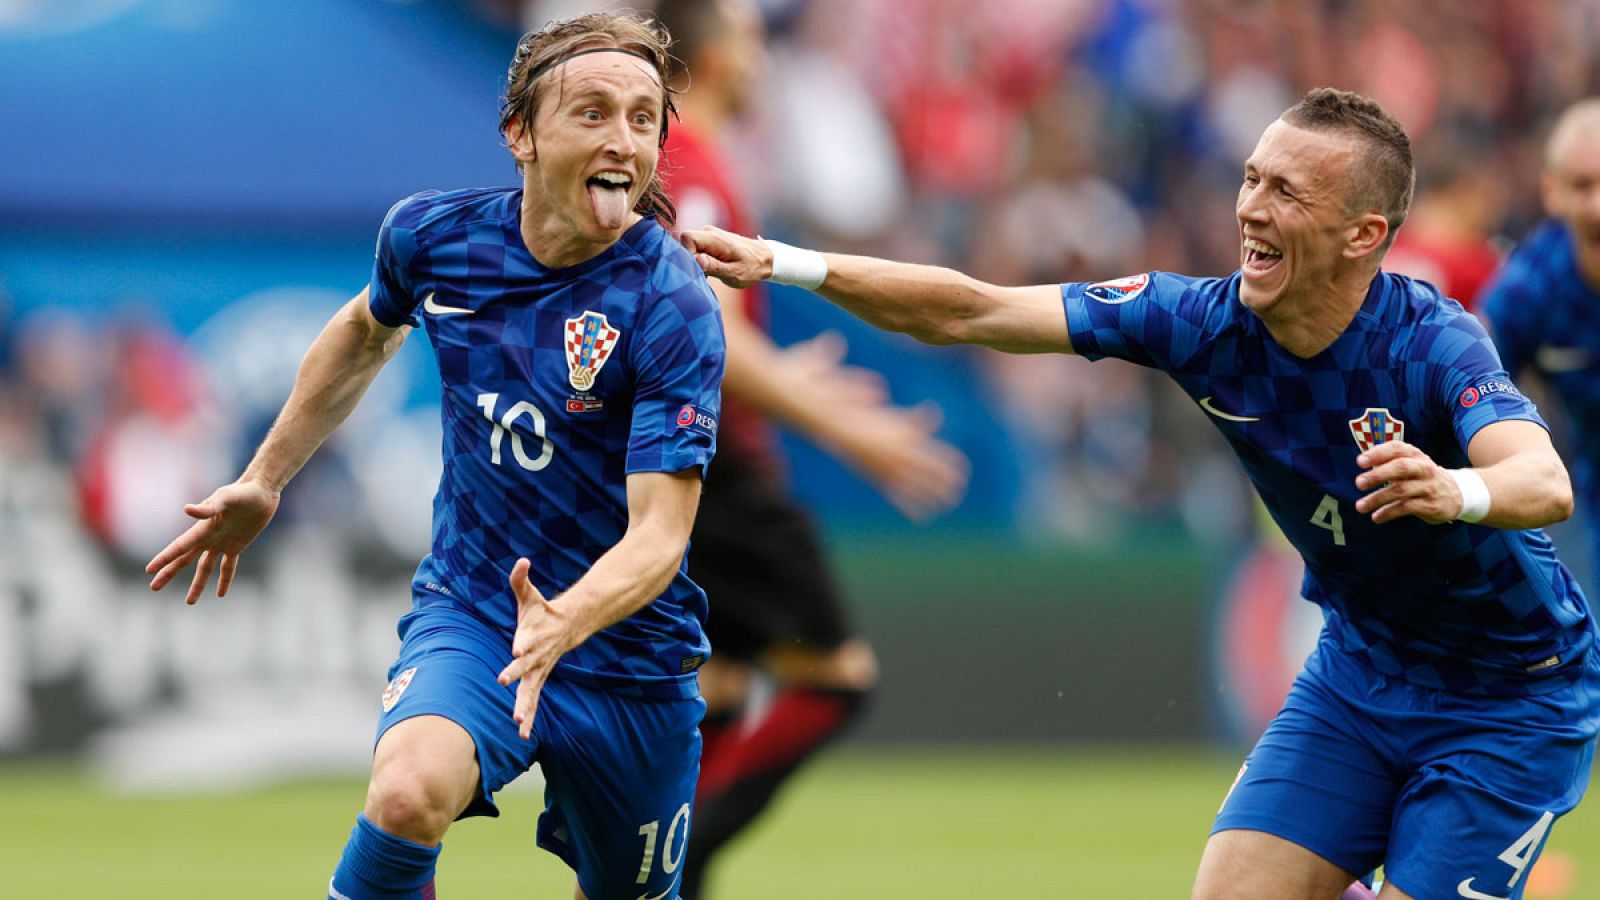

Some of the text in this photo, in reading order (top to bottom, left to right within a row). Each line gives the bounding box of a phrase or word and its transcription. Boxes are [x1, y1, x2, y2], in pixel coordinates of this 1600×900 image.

[1478, 382, 1521, 401] RESPEC
[477, 392, 555, 472] 10
[1309, 494, 1347, 546] 4
[636, 803, 690, 884] 10
[1497, 810, 1554, 888] 4
